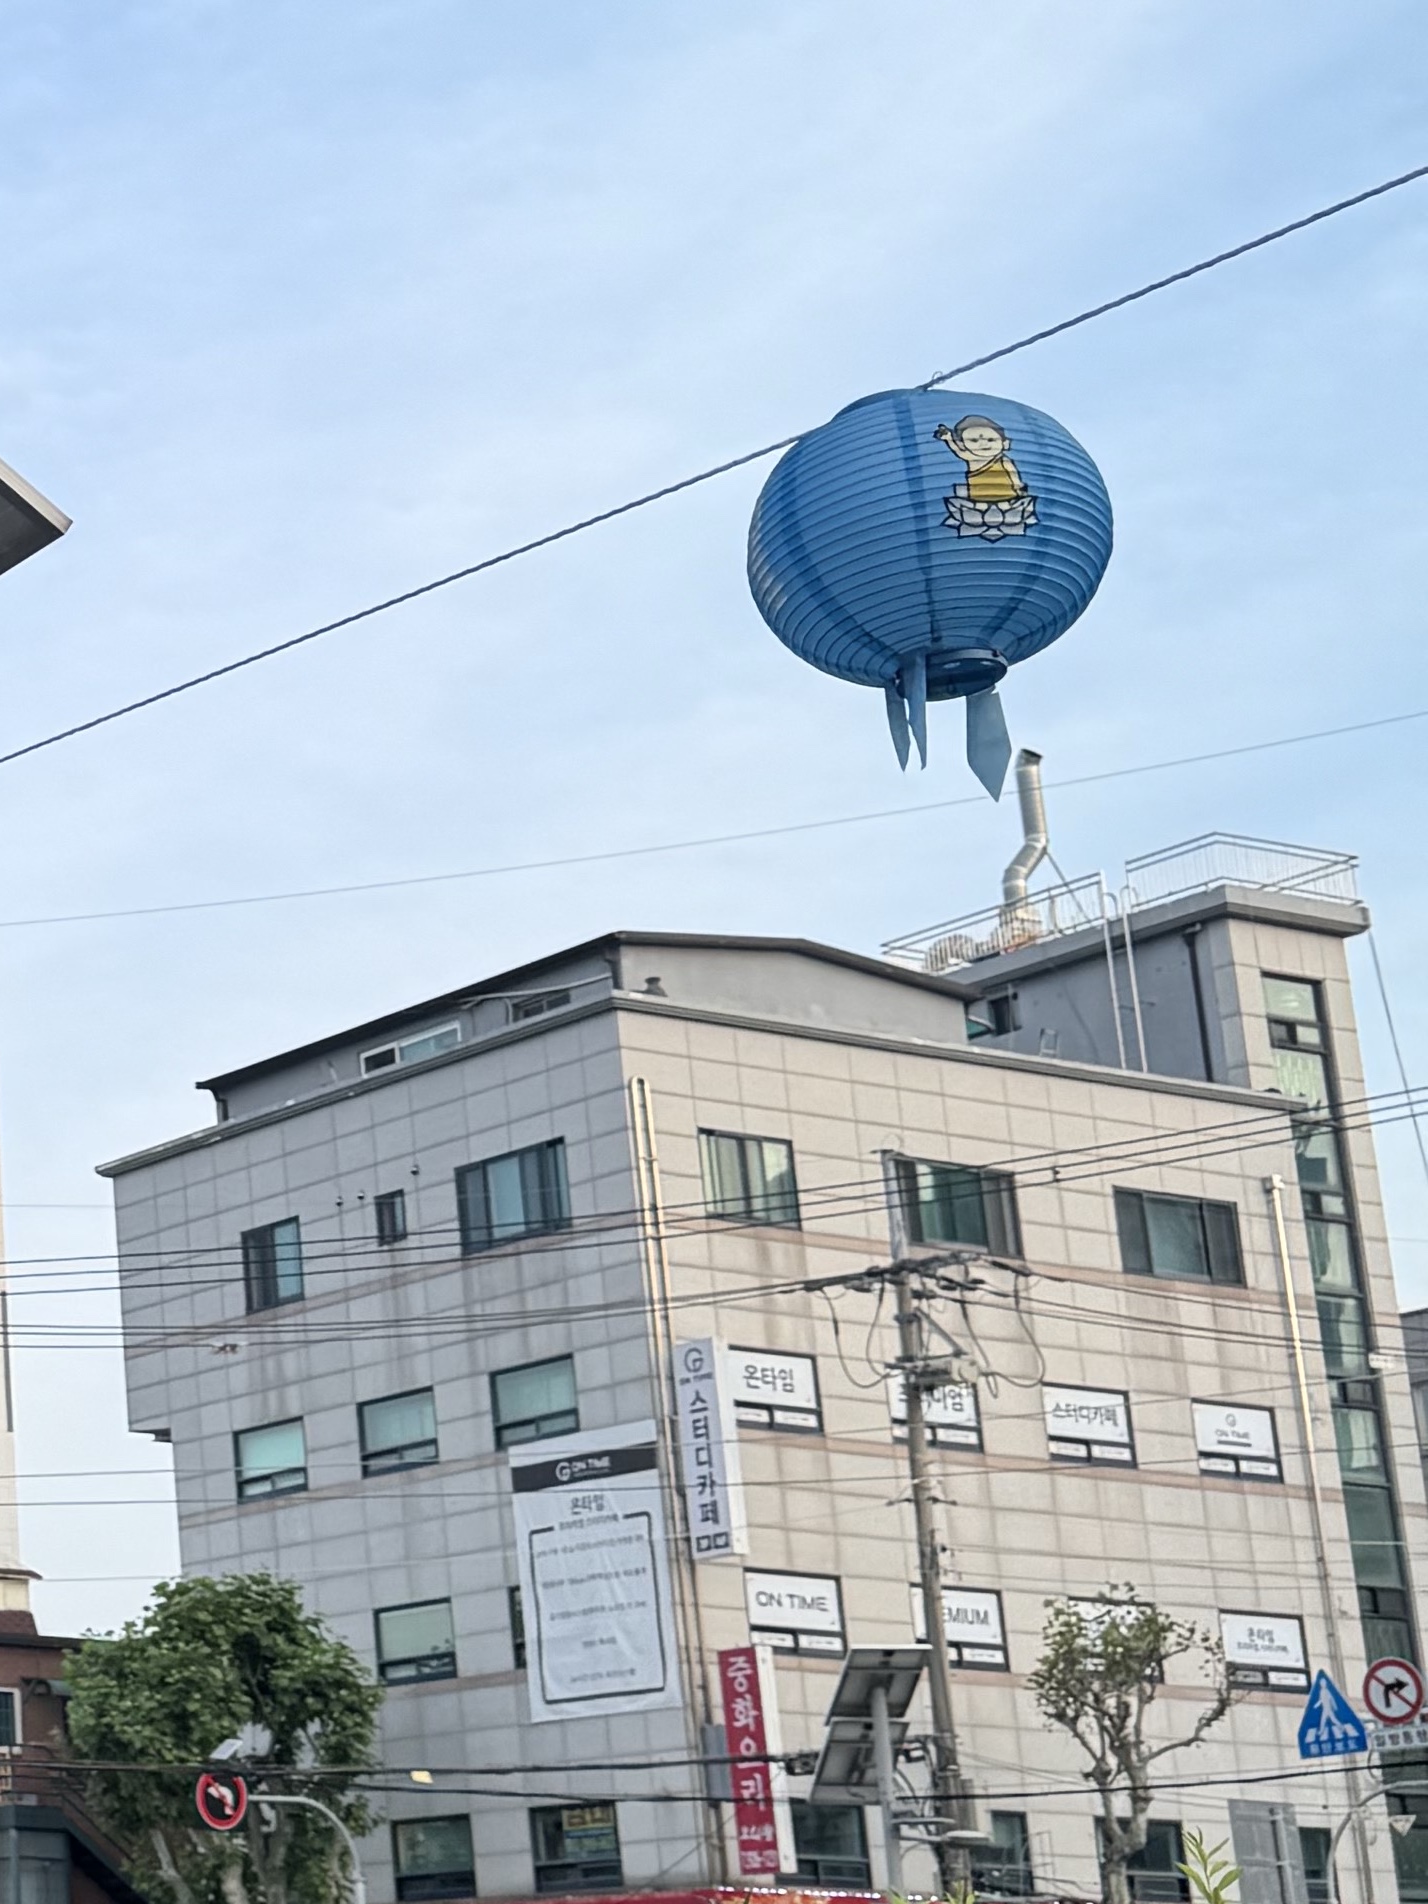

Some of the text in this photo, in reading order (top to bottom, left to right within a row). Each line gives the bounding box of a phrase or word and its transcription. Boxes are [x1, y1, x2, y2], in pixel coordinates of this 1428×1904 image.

[742, 1364, 796, 1394] 온타임
[1051, 1401, 1119, 1428] 스터디카페
[689, 1388, 721, 1526] 스터디카페
[755, 1590, 830, 1613] ON TIME
